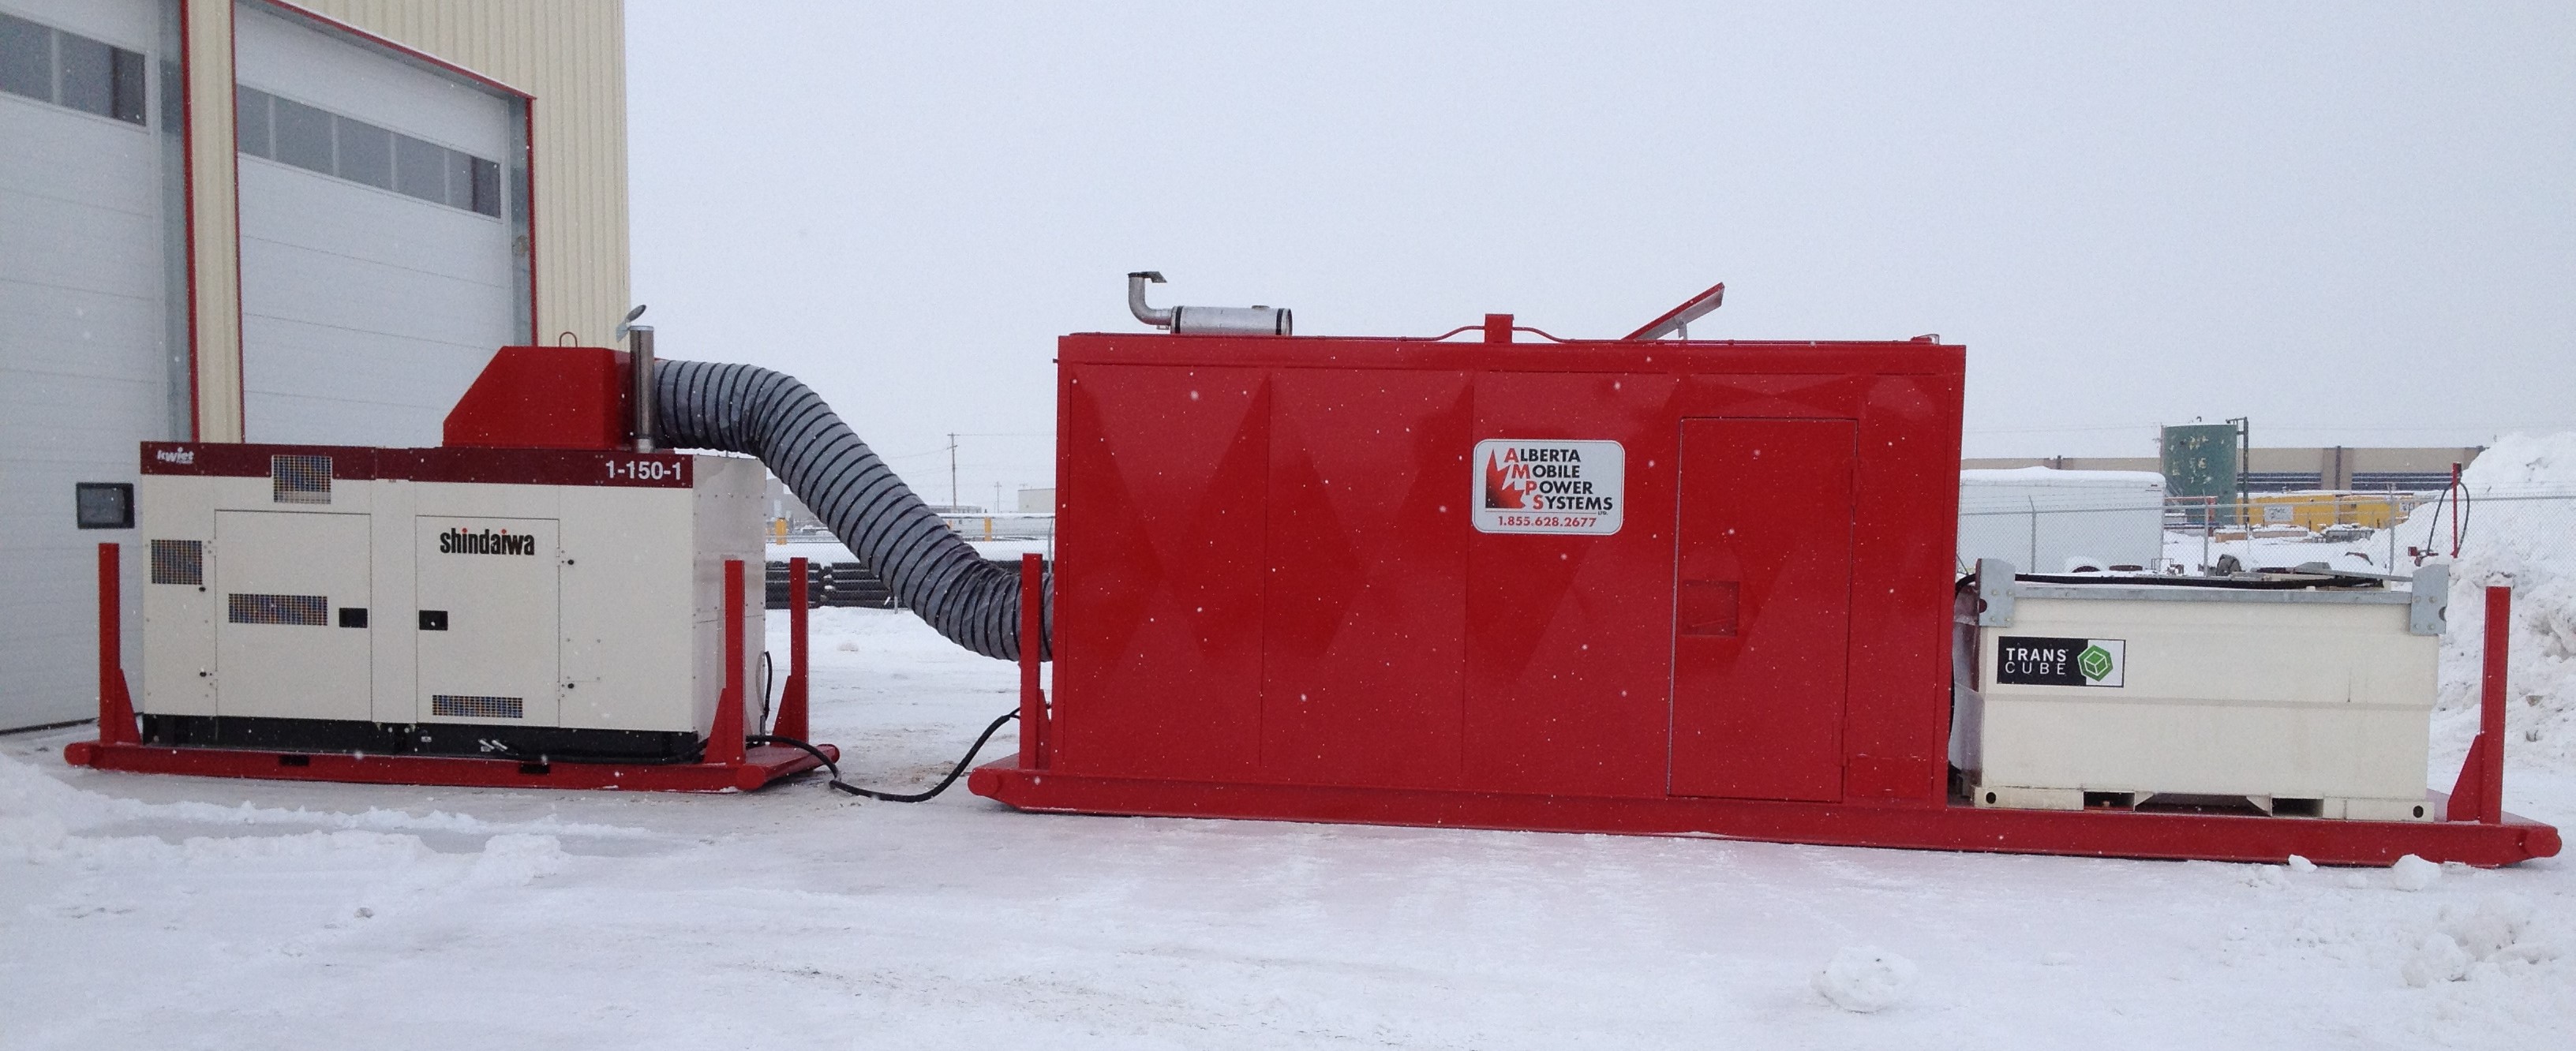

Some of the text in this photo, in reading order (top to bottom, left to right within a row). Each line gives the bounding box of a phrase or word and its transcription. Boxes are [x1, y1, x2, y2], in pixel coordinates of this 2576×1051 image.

[1504, 447, 1581, 463] ALBERTA
[605, 460, 681, 481] 1-150-1
[1511, 464, 1580, 479] MOBILE
[1526, 481, 1593, 496] POWER
[1533, 495, 1612, 511] SYSTEMS
[1499, 516, 1597, 528] 1.855.628.2677
[440, 527, 535, 555] shindaiwa
[2005, 662, 2066, 675] CUBE
